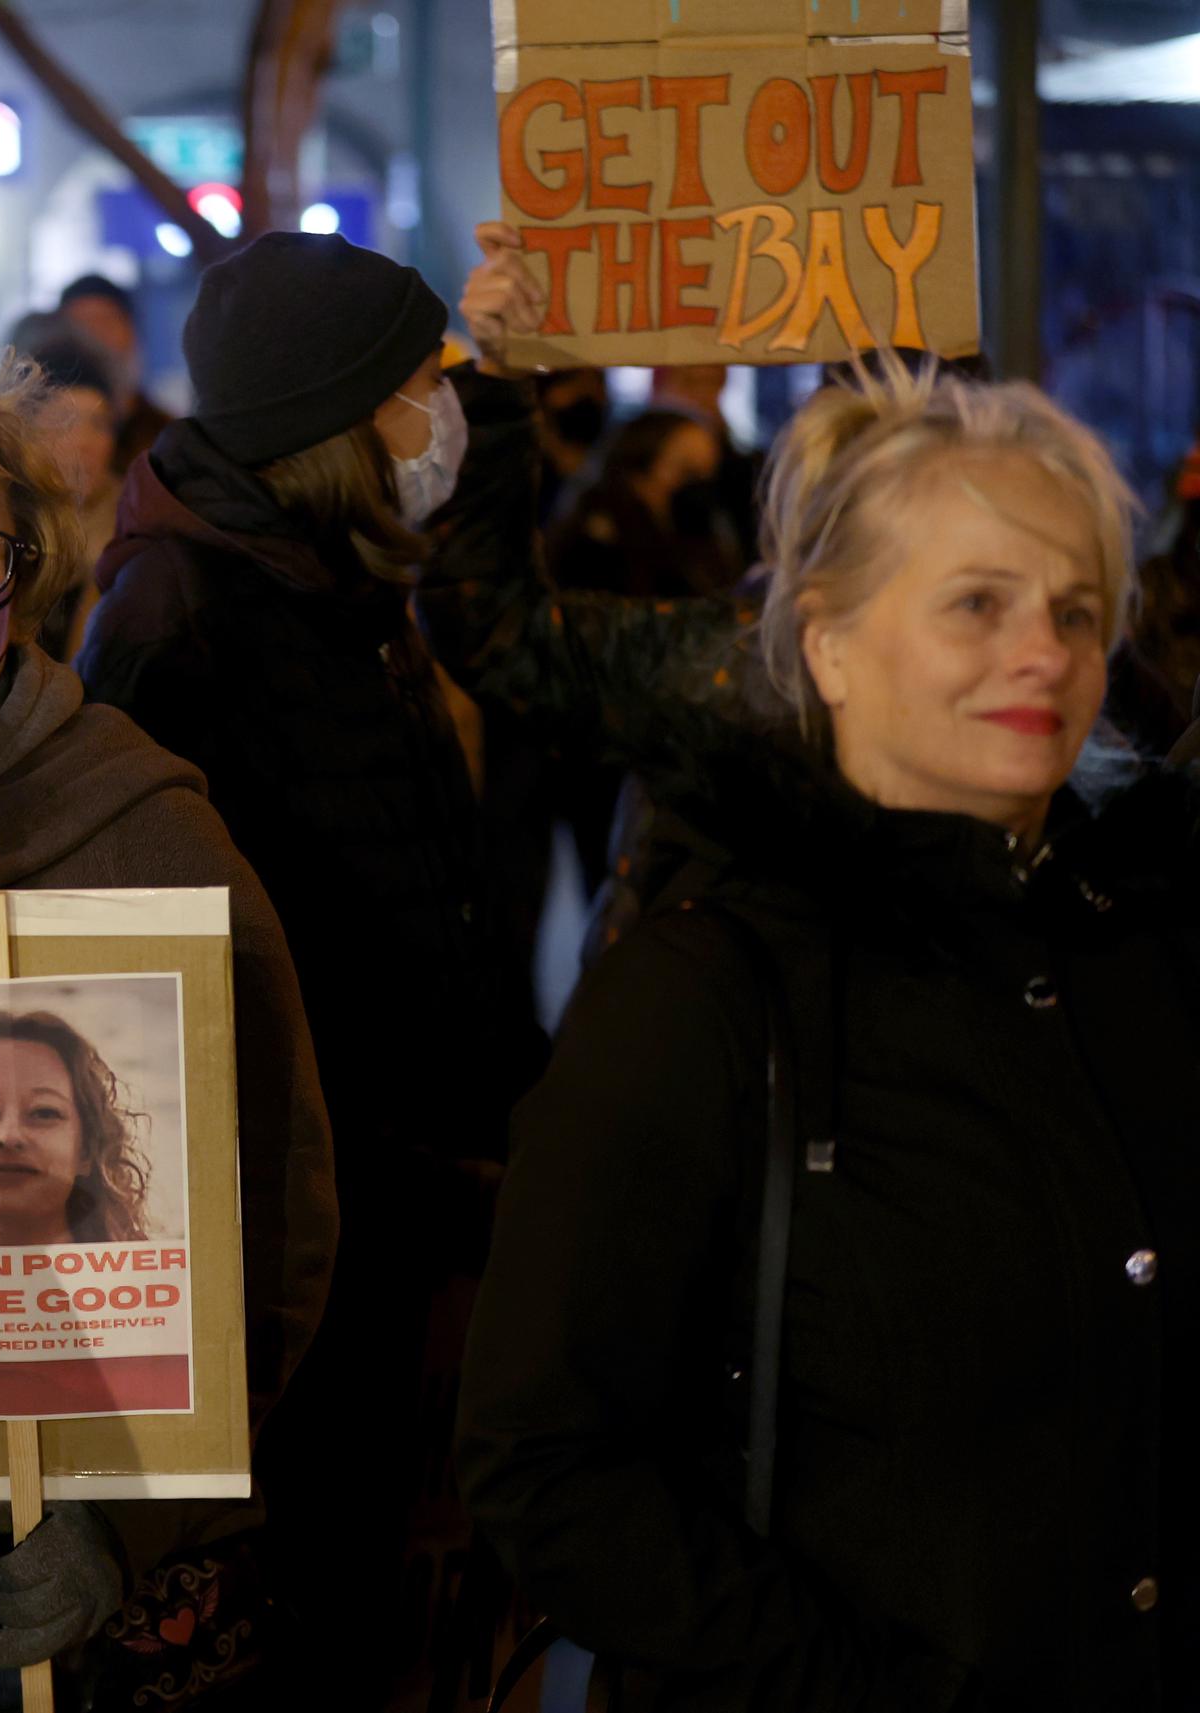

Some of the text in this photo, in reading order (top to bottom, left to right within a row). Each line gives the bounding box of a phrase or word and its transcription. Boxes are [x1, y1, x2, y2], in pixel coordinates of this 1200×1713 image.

[499, 66, 947, 220] GET OUT
[519, 202, 942, 351] THE BAY
[21, 1248, 187, 1276] POWER
[35, 1284, 182, 1314] GOOD
[59, 1316, 166, 1331] OBSERVER
[41, 1339, 68, 1350] BY
[73, 1337, 105, 1349] ICE
